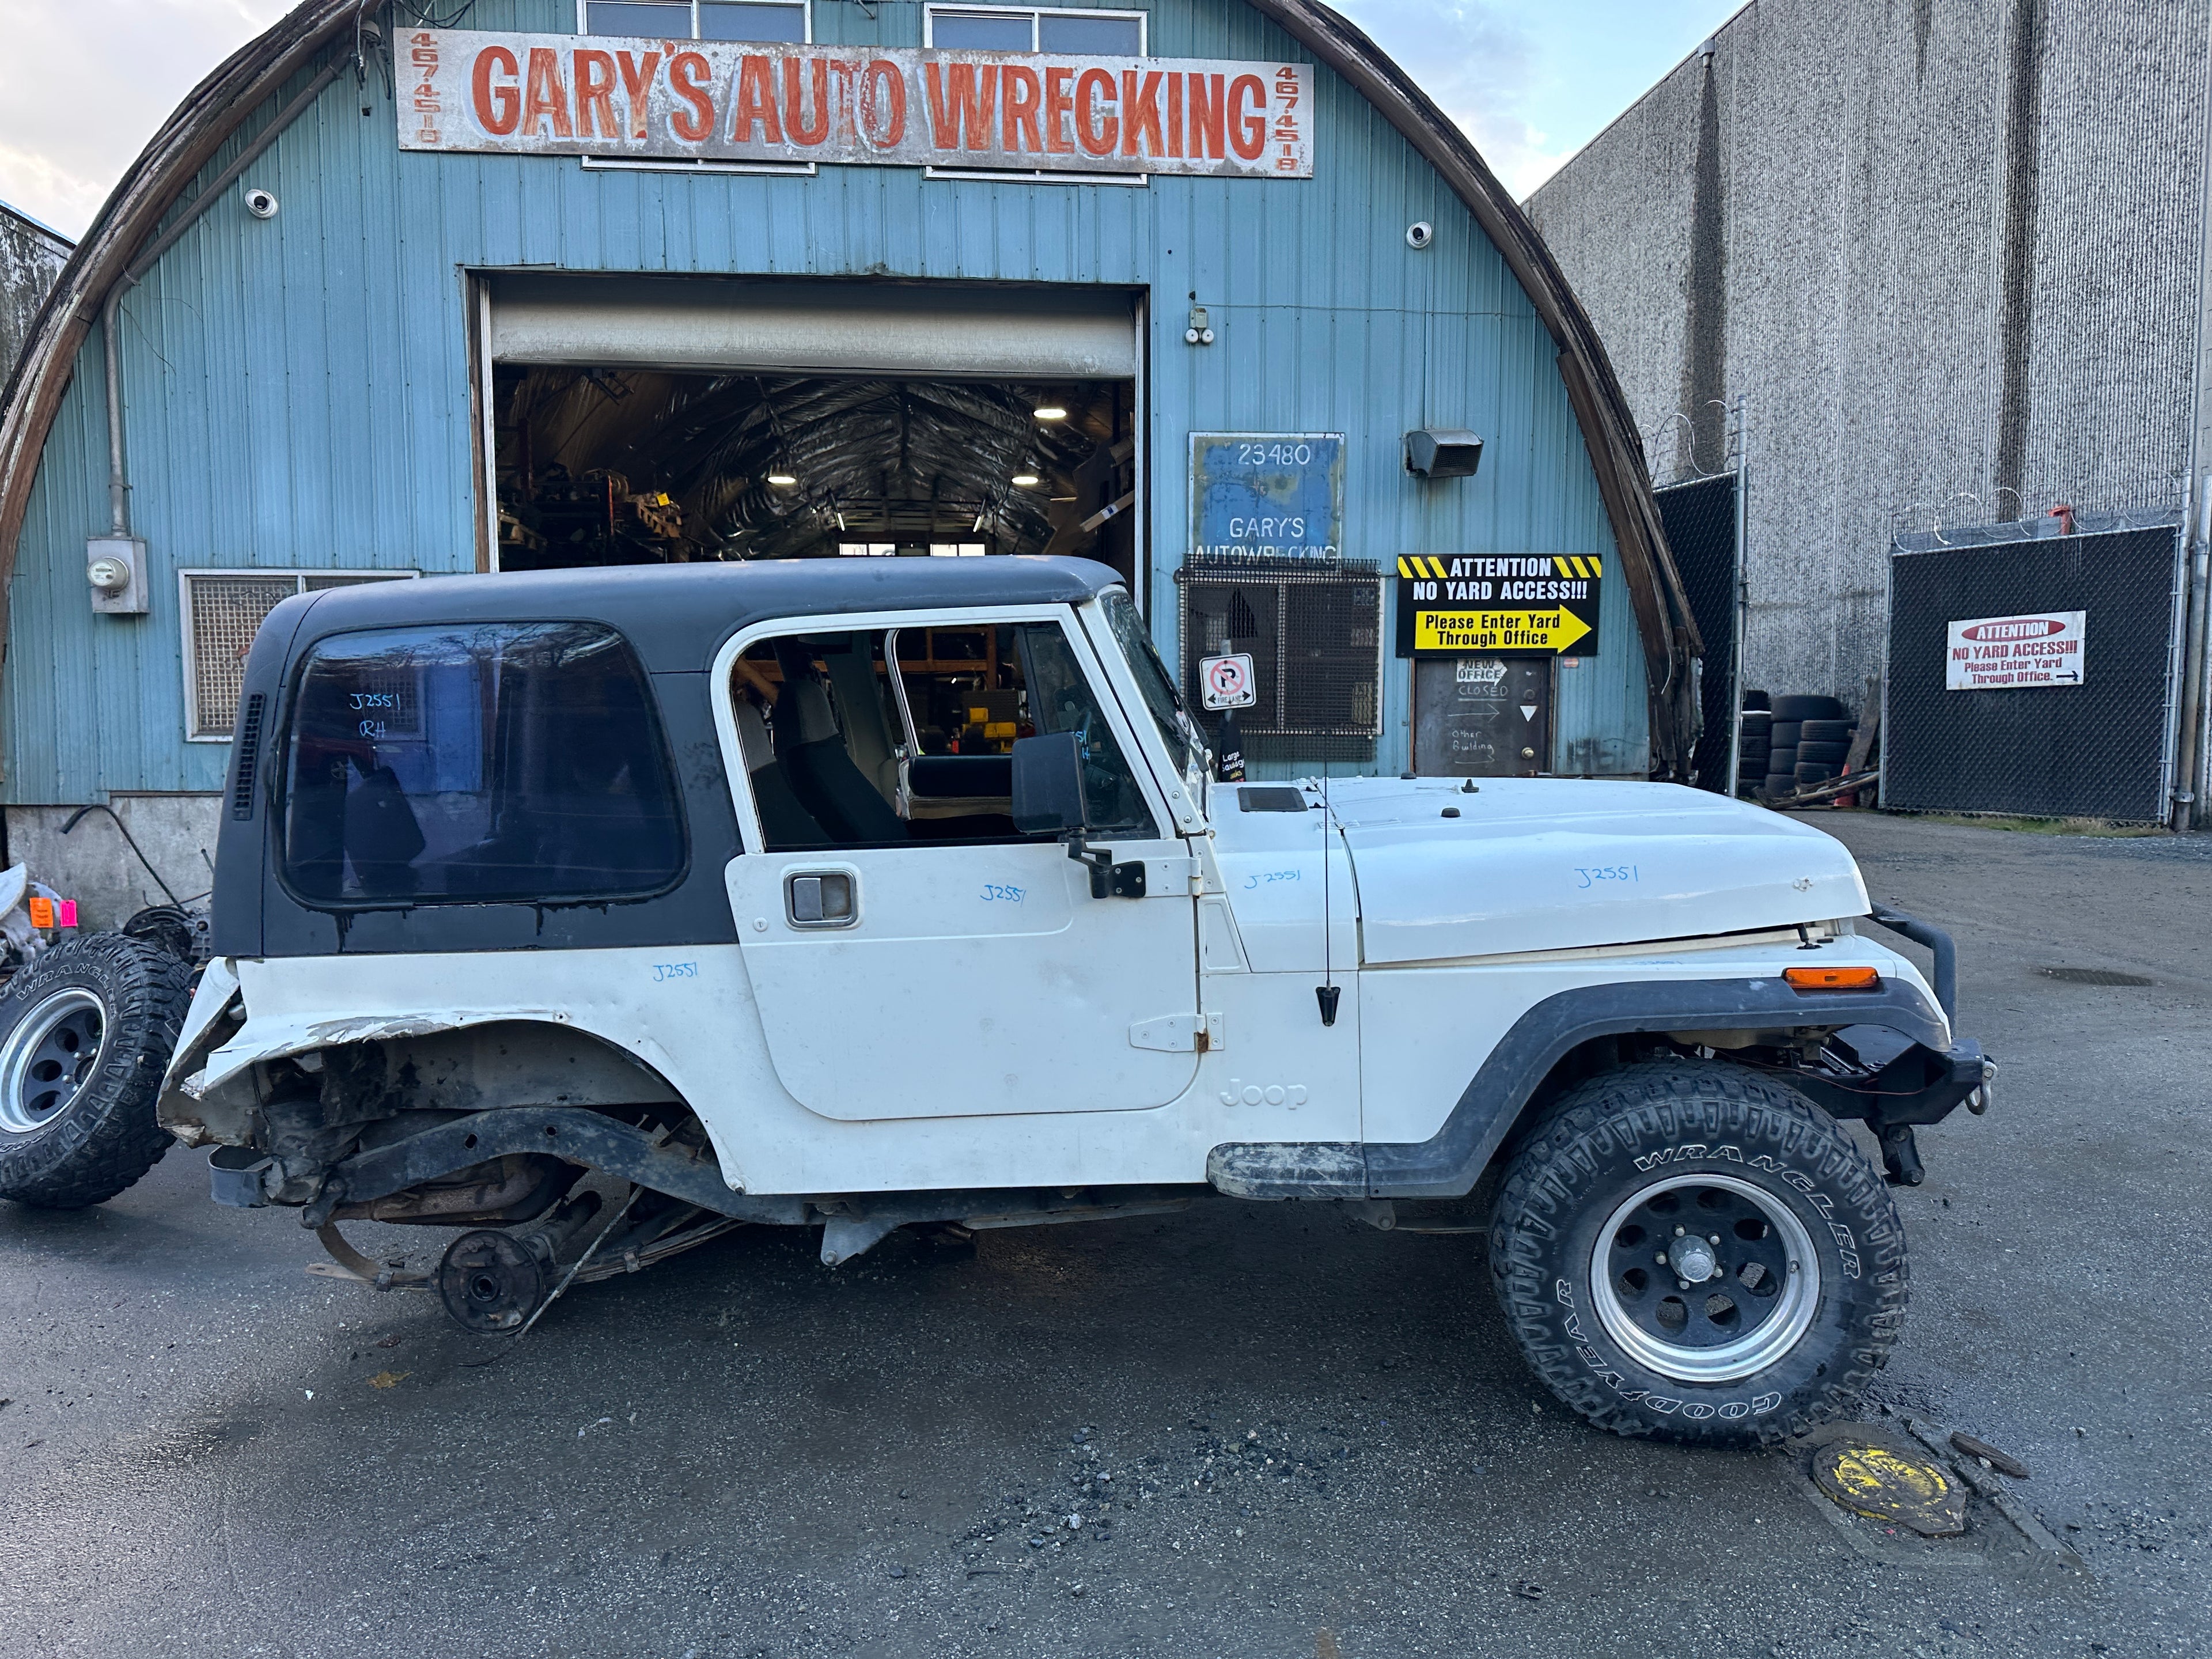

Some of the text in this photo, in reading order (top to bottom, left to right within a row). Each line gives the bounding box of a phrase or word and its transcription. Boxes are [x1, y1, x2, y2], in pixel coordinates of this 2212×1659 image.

[472, 43, 1268, 161] GARY'S AUTO WRECKING
[1238, 443, 1311, 465] 23480
[1229, 517, 1305, 538] GARY'S
[1450, 557, 1551, 577] ATTENTION
[1413, 581, 1588, 600] NO YARD ACCESS!!!
[1425, 613, 1560, 630] Please Enter Yard
[1976, 622, 2050, 640] ATTENTION
[1437, 630, 1548, 647] Through Office
[1952, 640, 2078, 661] NO YARD ACCESS!!!
[1465, 659, 1495, 669] NEW
[1964, 657, 2062, 673] Please Enter Yard
[1458, 669, 1501, 680] OFFICE
[1972, 673, 2014, 684] Through
[1459, 685, 1508, 696] CLOSED
[350, 693, 400, 710] J2551
[359, 720, 386, 738] RH
[1222, 751, 1240, 762] Large
[1222, 759, 1245, 772] Sausag
[1244, 870, 1300, 889] J2551
[1574, 865, 1638, 888] J2551
[980, 885, 1027, 908] J2551
[653, 961, 698, 982] J2551
[16, 963, 117, 1020] WRANGLER
[1633, 1143, 1861, 1280] WRANGLER
[1555, 1279, 1782, 1419] GOODYEAR
